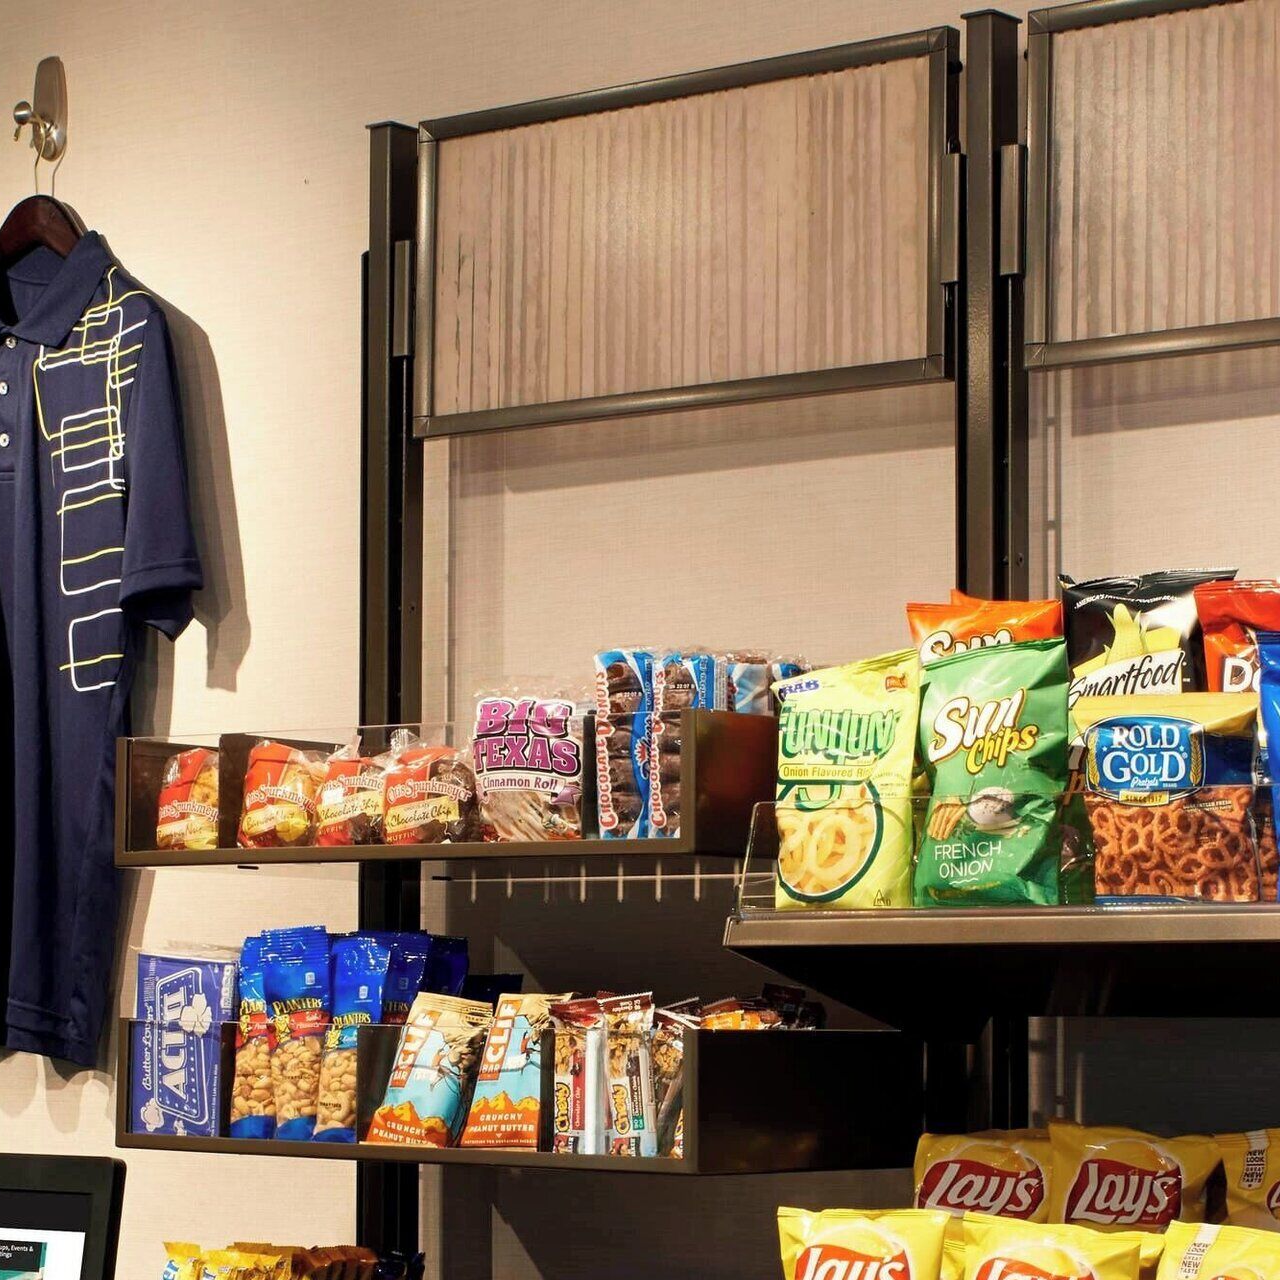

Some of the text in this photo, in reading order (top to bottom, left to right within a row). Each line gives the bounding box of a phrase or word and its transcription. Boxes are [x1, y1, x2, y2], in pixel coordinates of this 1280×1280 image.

[1069, 651, 1184, 710] Smartfood
[477, 700, 570, 737] BIG
[929, 689, 1025, 761] Sun
[967, 724, 1039, 774] Chips
[1111, 725, 1180, 749] ROLD
[474, 736, 579, 774] TEXAS
[1102, 751, 1186, 780] GOLD
[482, 776, 558, 791] Cinnamon Roll
[784, 767, 852, 777] Onion Flavored
[406, 778, 473, 802] Spunkmeyer
[934, 841, 1002, 860] FRENCH
[939, 859, 994, 879] ONION
[272, 999, 322, 1014] PLANTERS
[332, 1012, 371, 1030] PLANTERS
[162, 1030, 188, 1100] ACT
[480, 1113, 522, 1121] CRUNCHY
[501, 1124, 534, 1132] BUTTER
[920, 1162, 1041, 1216] Lay's
[1070, 1163, 1181, 1225] Lay's
